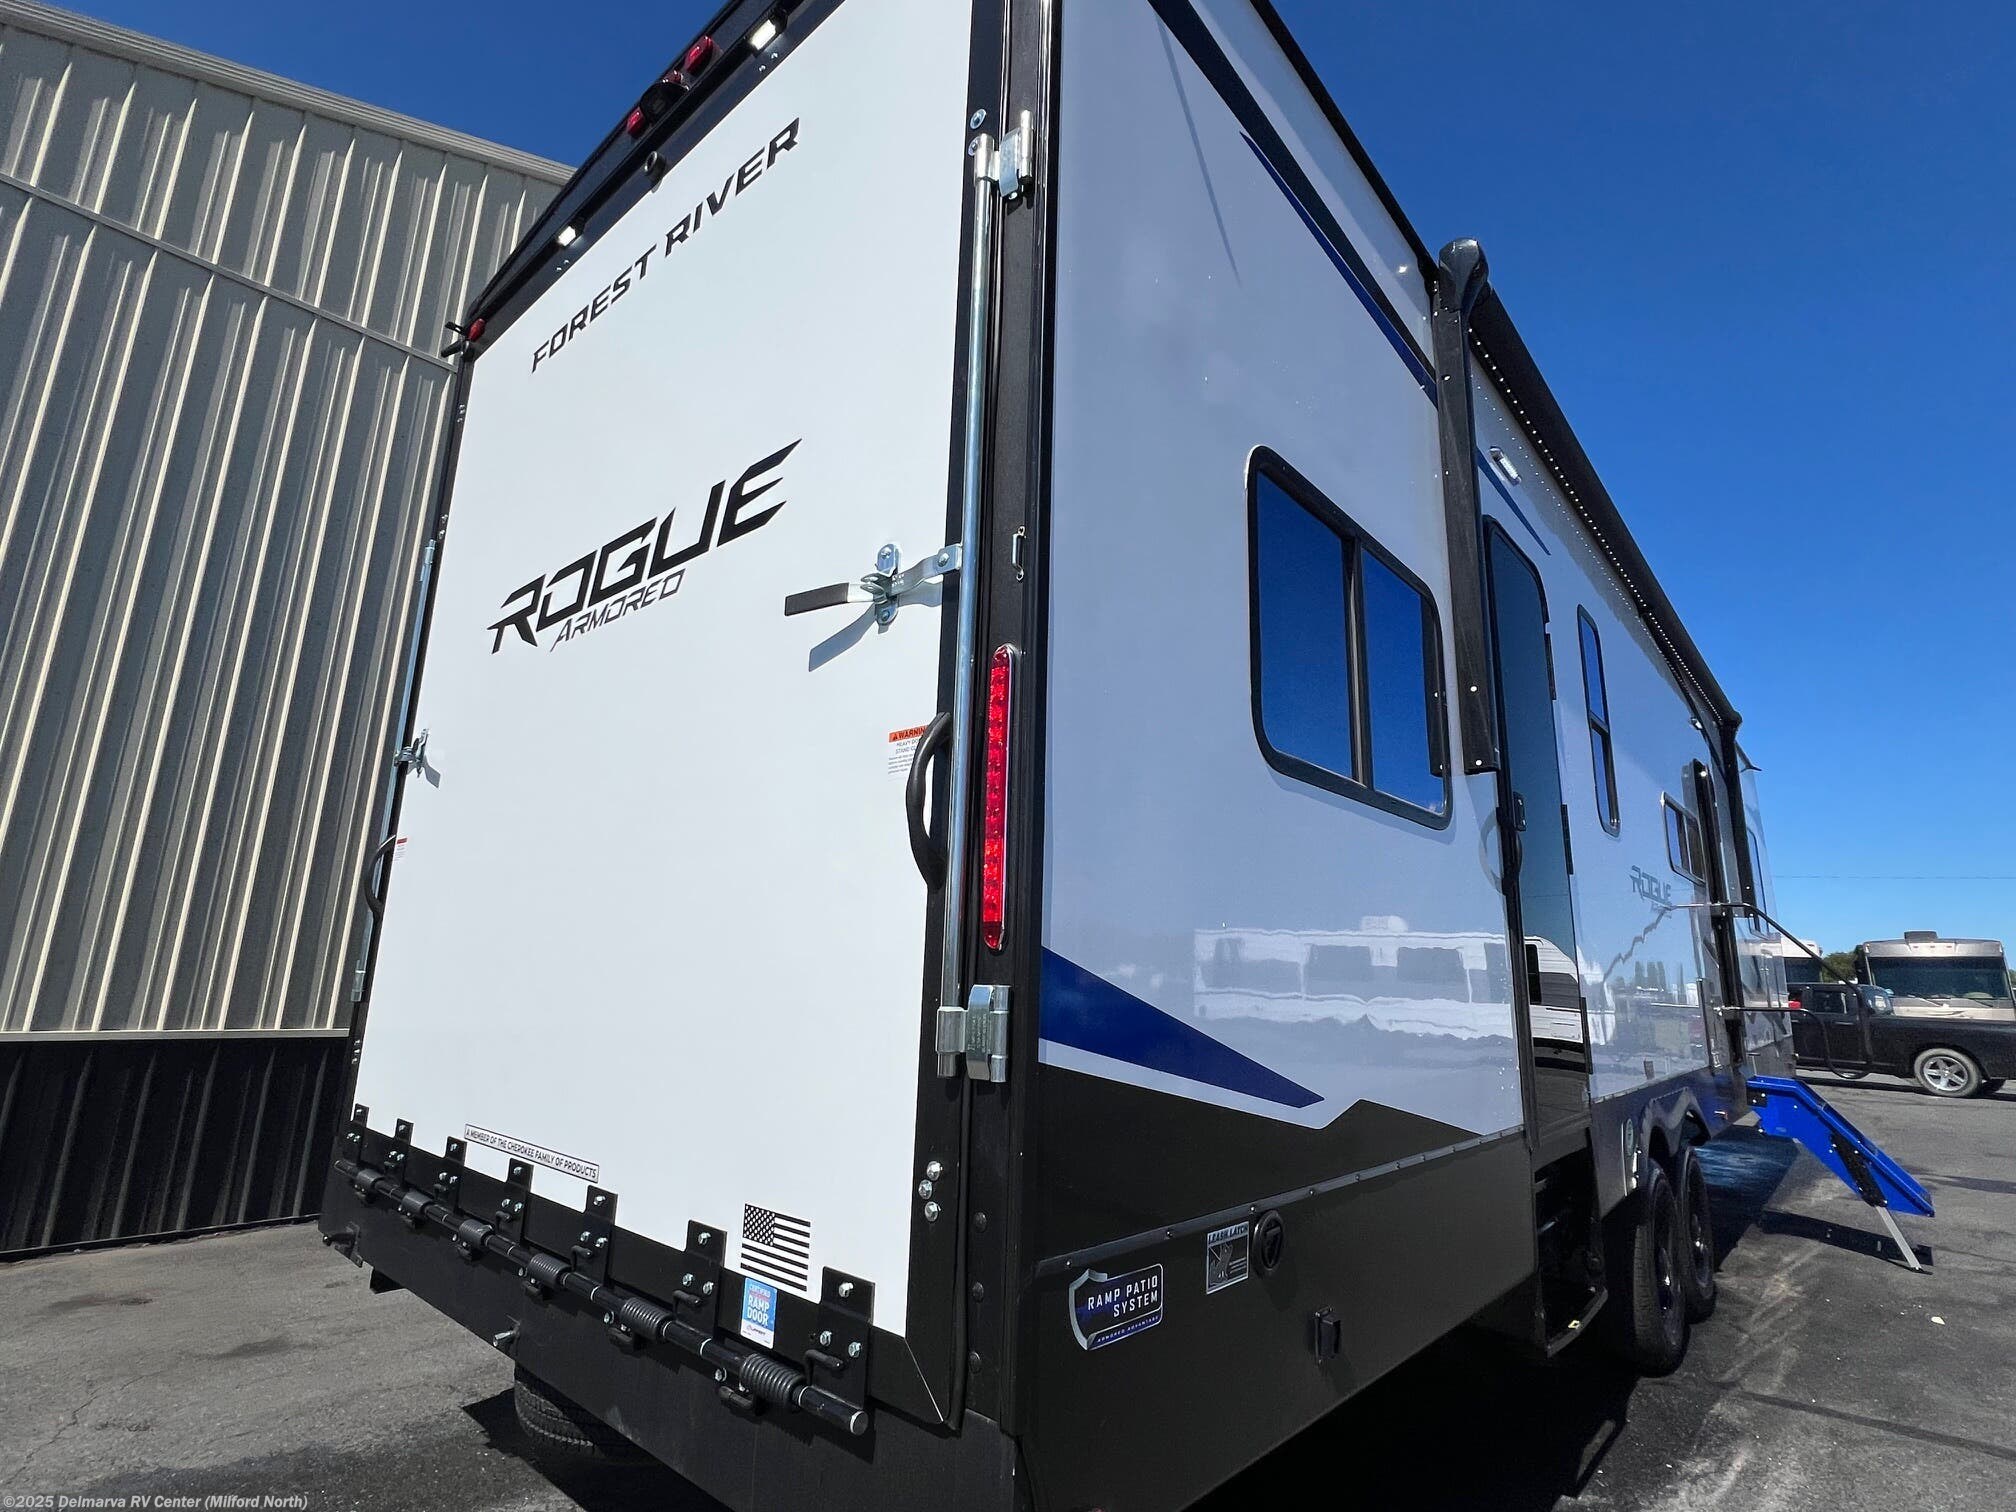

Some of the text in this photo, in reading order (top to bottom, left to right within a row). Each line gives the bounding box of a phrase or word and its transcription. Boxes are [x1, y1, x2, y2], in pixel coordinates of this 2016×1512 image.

[532, 117, 799, 373] FOREST RIVER
[487, 438, 802, 654] ROGUE
[550, 568, 686, 652] ARMORED
[1629, 865, 1672, 904] ROGUE
[471, 1130, 490, 1142] MEMBER
[490, 1136, 497, 1144] OF
[498, 1138, 507, 1149] THE
[508, 1141, 534, 1158] CHEROKEE
[535, 1150, 555, 1164] FAMILY
[555, 1157, 564, 1167] OF
[564, 1160, 597, 1179] PRODUCTS
[1208, 1223, 1248, 1245] LEASH LATCH
[748, 1295, 770, 1313] RAMP
[1088, 1275, 1158, 1311] RAMP PATIO
[1113, 1290, 1158, 1318] SYSTEM
[747, 1306, 768, 1326] DOOR
